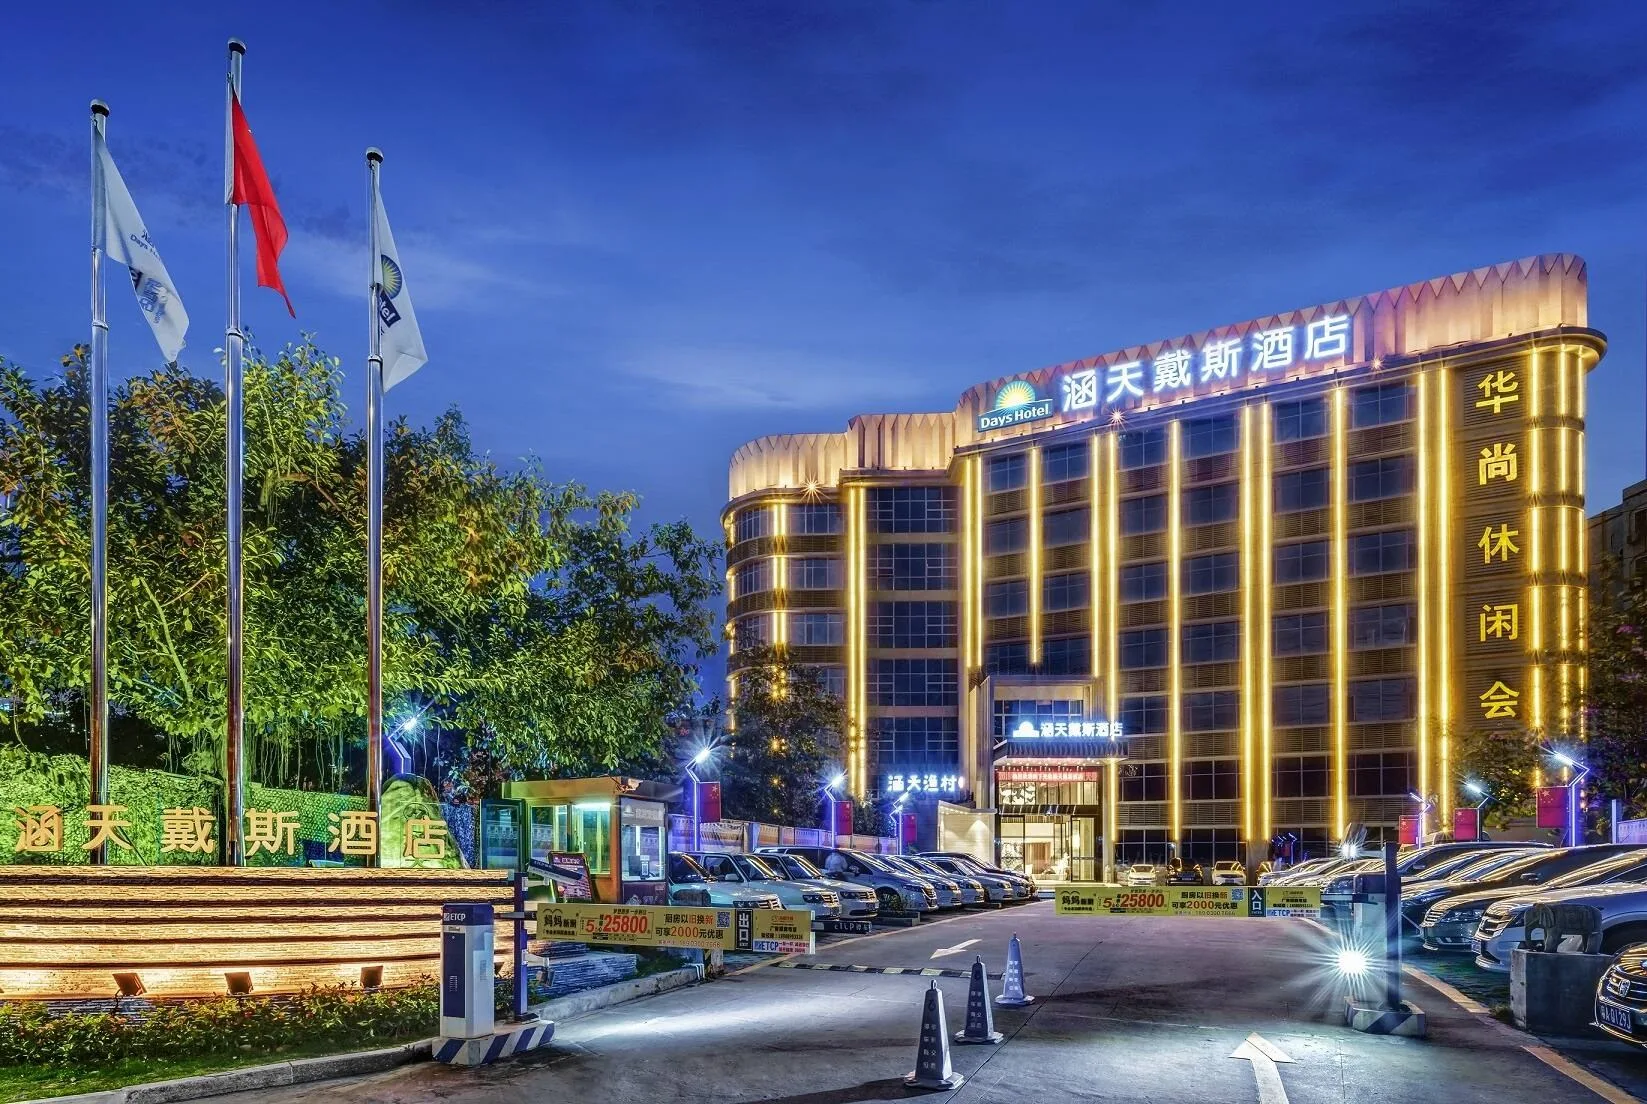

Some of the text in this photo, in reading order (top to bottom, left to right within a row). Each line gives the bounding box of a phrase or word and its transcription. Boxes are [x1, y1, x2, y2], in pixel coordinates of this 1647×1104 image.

[1061, 313, 1350, 412] 涵天戴斯酒店
[980, 403, 1050, 429] Days Hotel
[1476, 370, 1520, 720] 华尚休闲会
[1040, 721, 1123, 738] 涵天戴斯酒店
[887, 774, 957, 793] 涵天渔村
[14, 804, 450, 860] 涵天戴斯酒店
[1251, 889, 1262, 911] 入口
[450, 912, 466, 922] ETCP
[603, 914, 648, 934] 25800
[663, 913, 714, 925] 厨房以旧换新
[738, 912, 749, 941] 出口
[655, 925, 724, 940] 可享2000元优惠
[761, 941, 779, 951] ETCP
